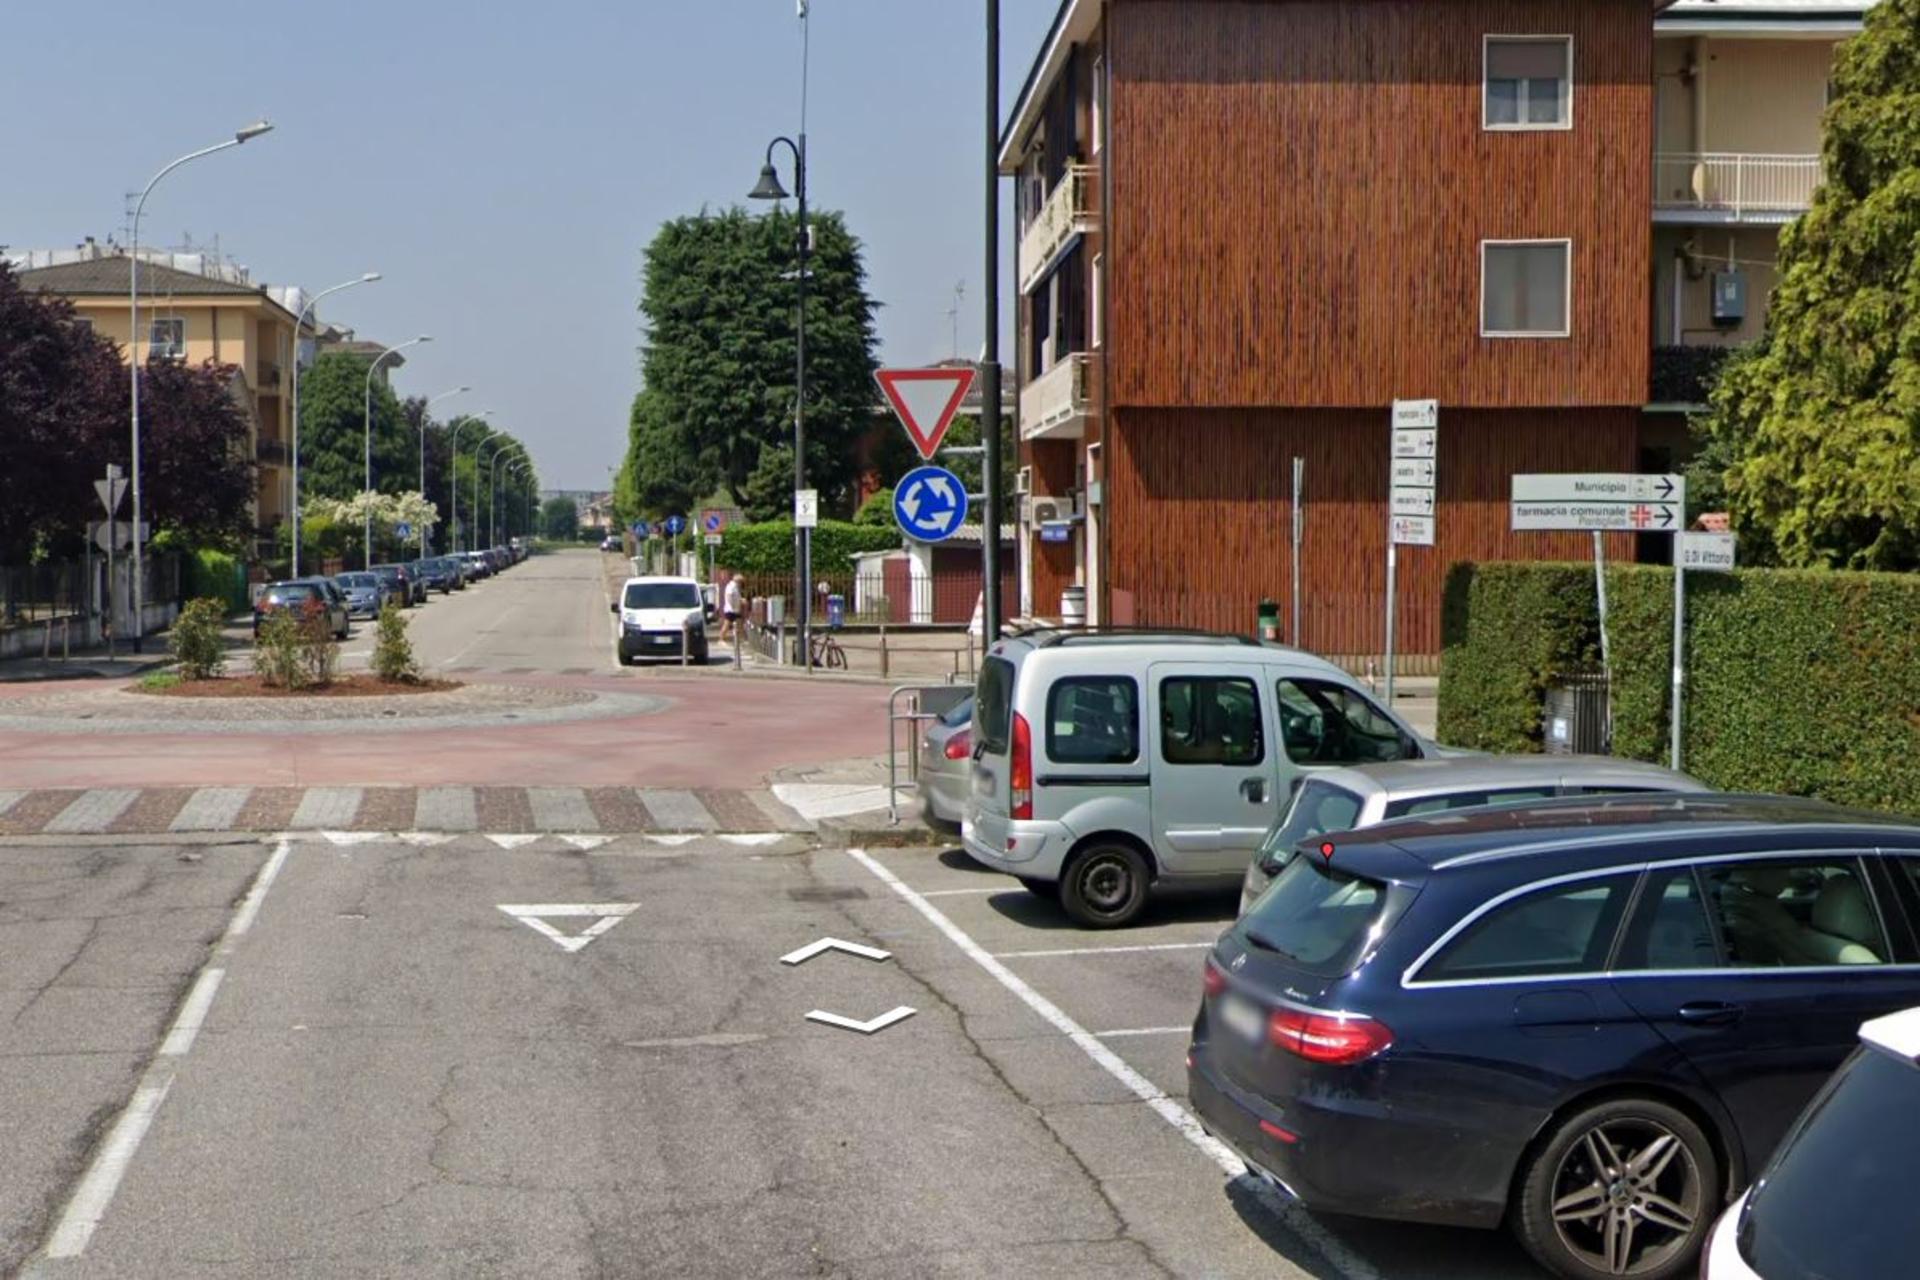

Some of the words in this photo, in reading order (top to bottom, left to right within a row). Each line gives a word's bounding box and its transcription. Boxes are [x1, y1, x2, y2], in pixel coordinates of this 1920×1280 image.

[1574, 481, 1627, 493] Municipio
[1516, 505, 1568, 516] farmacia
[1570, 505, 1627, 516] comunale
